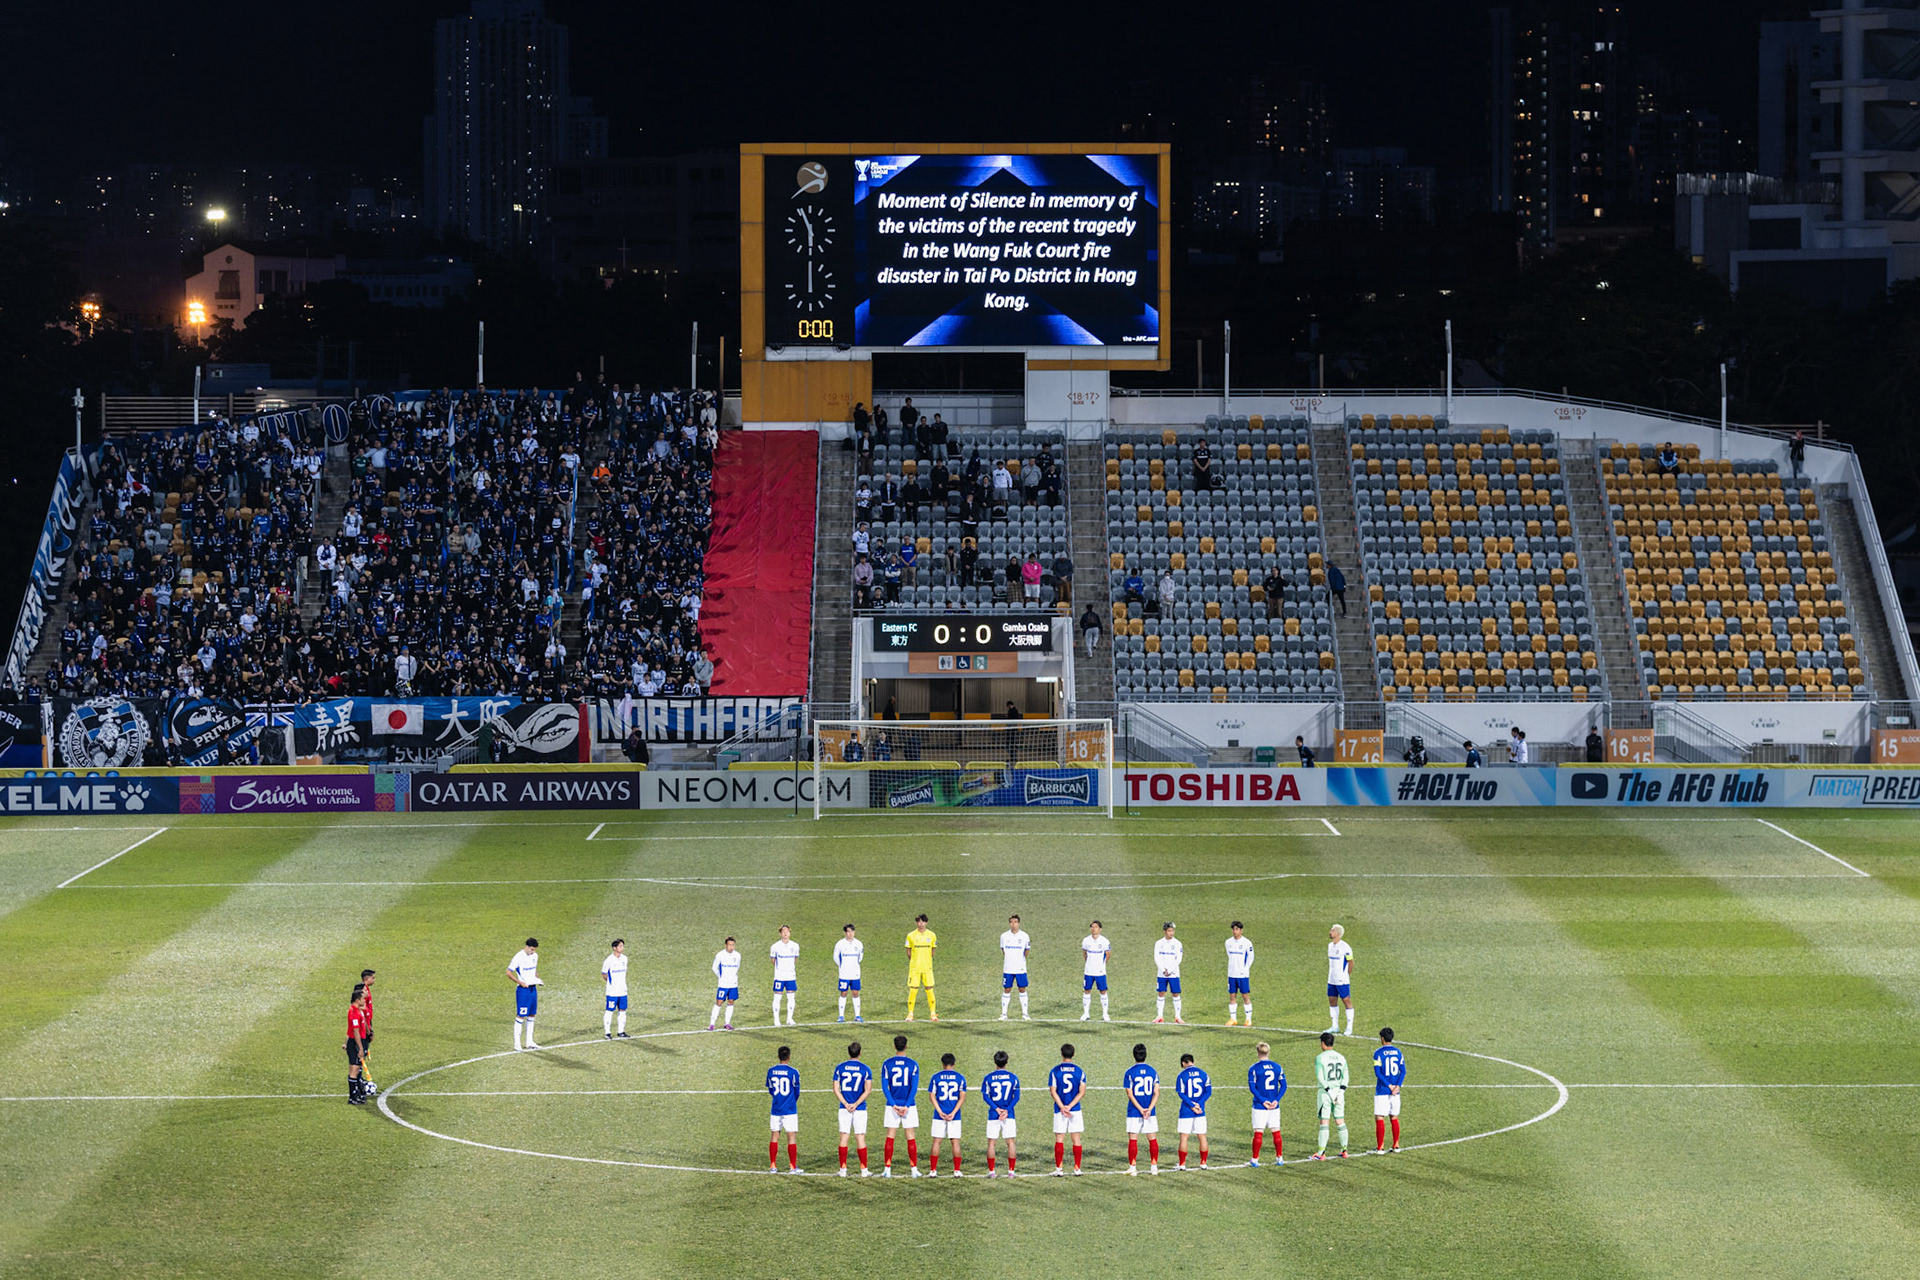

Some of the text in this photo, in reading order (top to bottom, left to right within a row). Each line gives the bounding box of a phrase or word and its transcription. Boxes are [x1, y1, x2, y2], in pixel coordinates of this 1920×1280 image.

[878, 191, 1138, 212] Moment of Silence in memory of
[878, 216, 1137, 237] the victims of the recent tragedy
[902, 241, 1112, 262] in the Wang Fuk Court fire
[877, 266, 1137, 287] disaster in Tai Po District in Hong
[983, 292, 1030, 311] Kong.
[798, 319, 834, 338] 0:00
[881, 622, 918, 633] Eastern FC
[933, 624, 950, 645] 0
[975, 624, 992, 644] 0
[1002, 622, 1049, 633] Gamba Osaka
[890, 635, 909, 647] 東方
[193, 715, 243, 748] PRIMA
[127, 732, 139, 757] OSAKA
[1069, 740, 1089, 760] 18
[1339, 738, 1359, 758] 17
[1610, 737, 1629, 757] 16
[1879, 738, 1899, 758] 15
[308, 786, 353, 796] Welcome
[419, 780, 631, 805] QATAR AIRWAYS
[658, 776, 852, 804] NEOM.COM
[890, 786, 933, 807] BARBICAN
[1030, 782, 1085, 794] BARBICAN
[1124, 773, 1301, 802] TOSHIBA
[1616, 772, 1770, 803] The AFC Hub
[1814, 779, 1863, 796] MATCH
[316, 795, 361, 805] to Arabia
[892, 1066, 910, 1087] 21
[1327, 1062, 1343, 1082] 26
[1385, 1056, 1400, 1077] 16
[771, 1077, 790, 1096] 30
[841, 1071, 862, 1092] 27
[937, 1080, 958, 1101] 32
[1063, 1073, 1074, 1094] 5
[1134, 1076, 1154, 1096] 20
[1187, 1077, 1203, 1099] 15
[1264, 1070, 1276, 1090] 2
[990, 1080, 1012, 1102] 37
